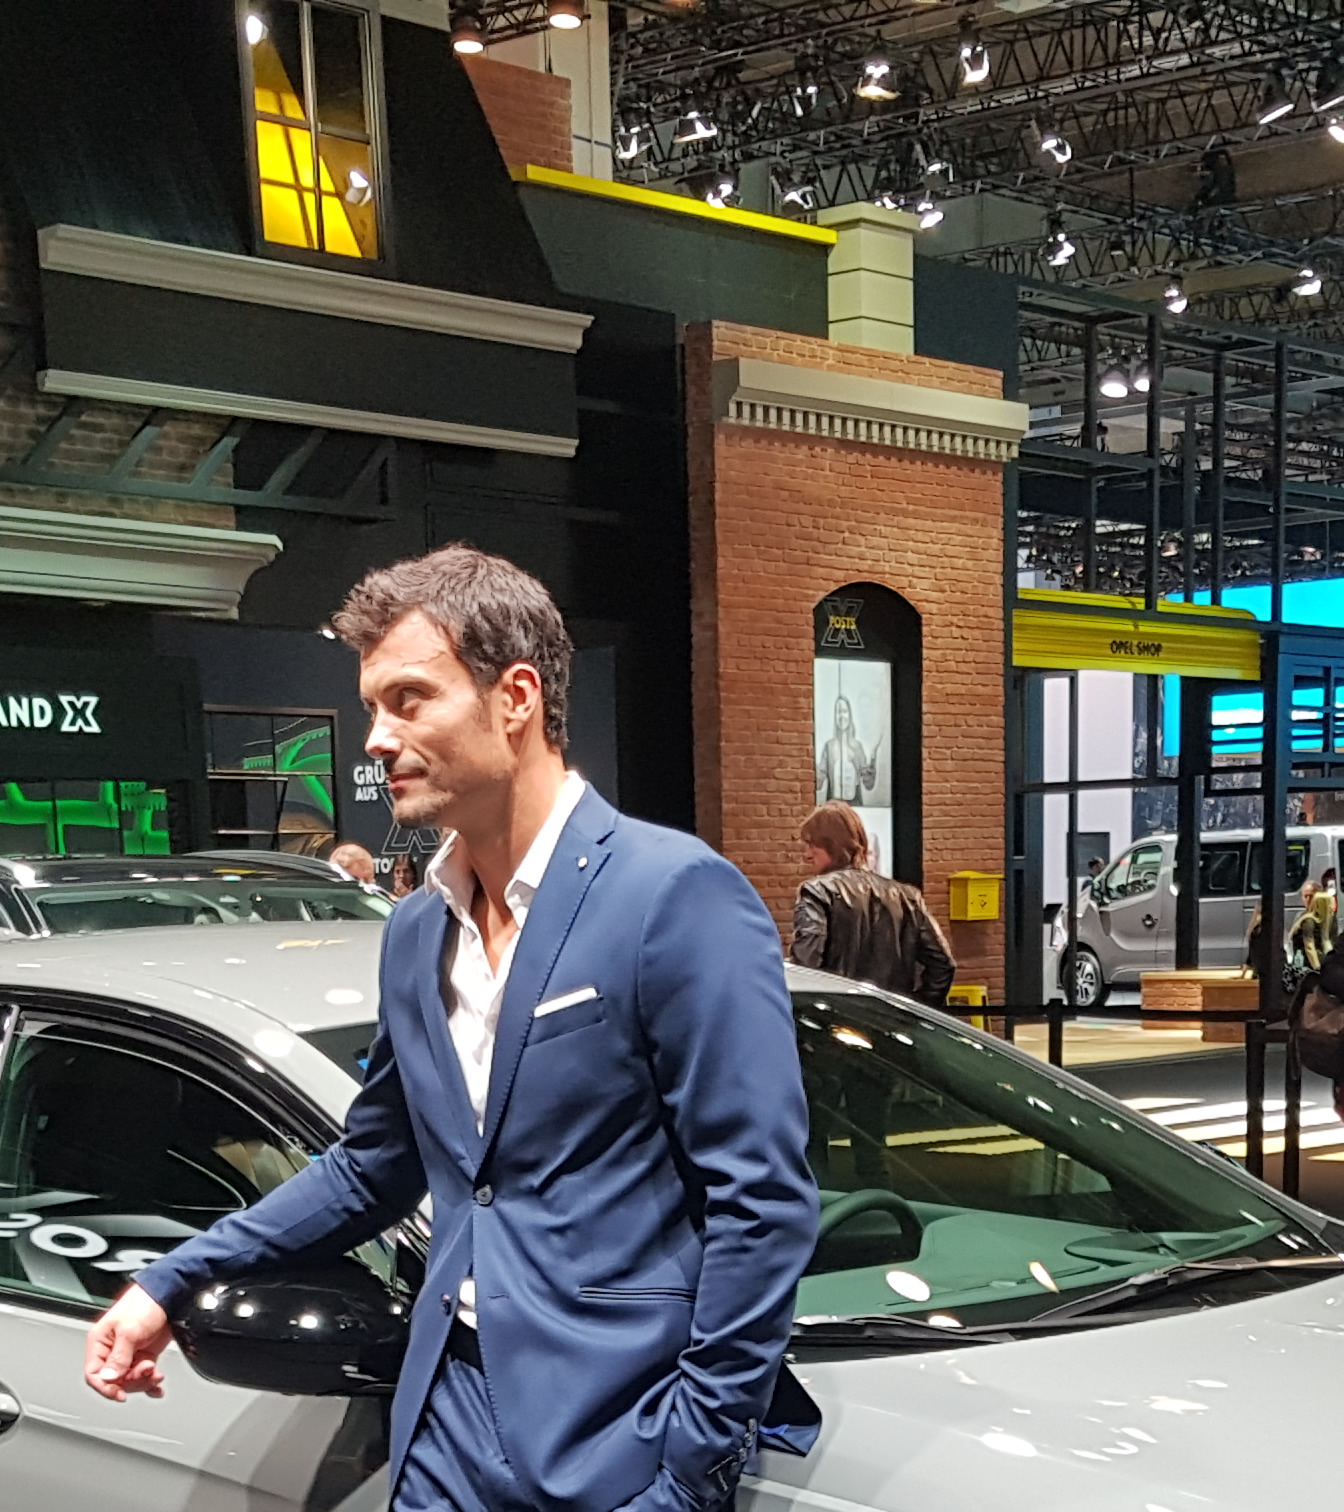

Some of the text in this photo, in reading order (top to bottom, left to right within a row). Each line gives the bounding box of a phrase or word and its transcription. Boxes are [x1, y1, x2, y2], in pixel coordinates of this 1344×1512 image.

[829, 615, 857, 630] POSTS
[1110, 640, 1163, 657] OPEL SHOP
[58, 695, 102, 734] X
[355, 786, 378, 802] AUS
